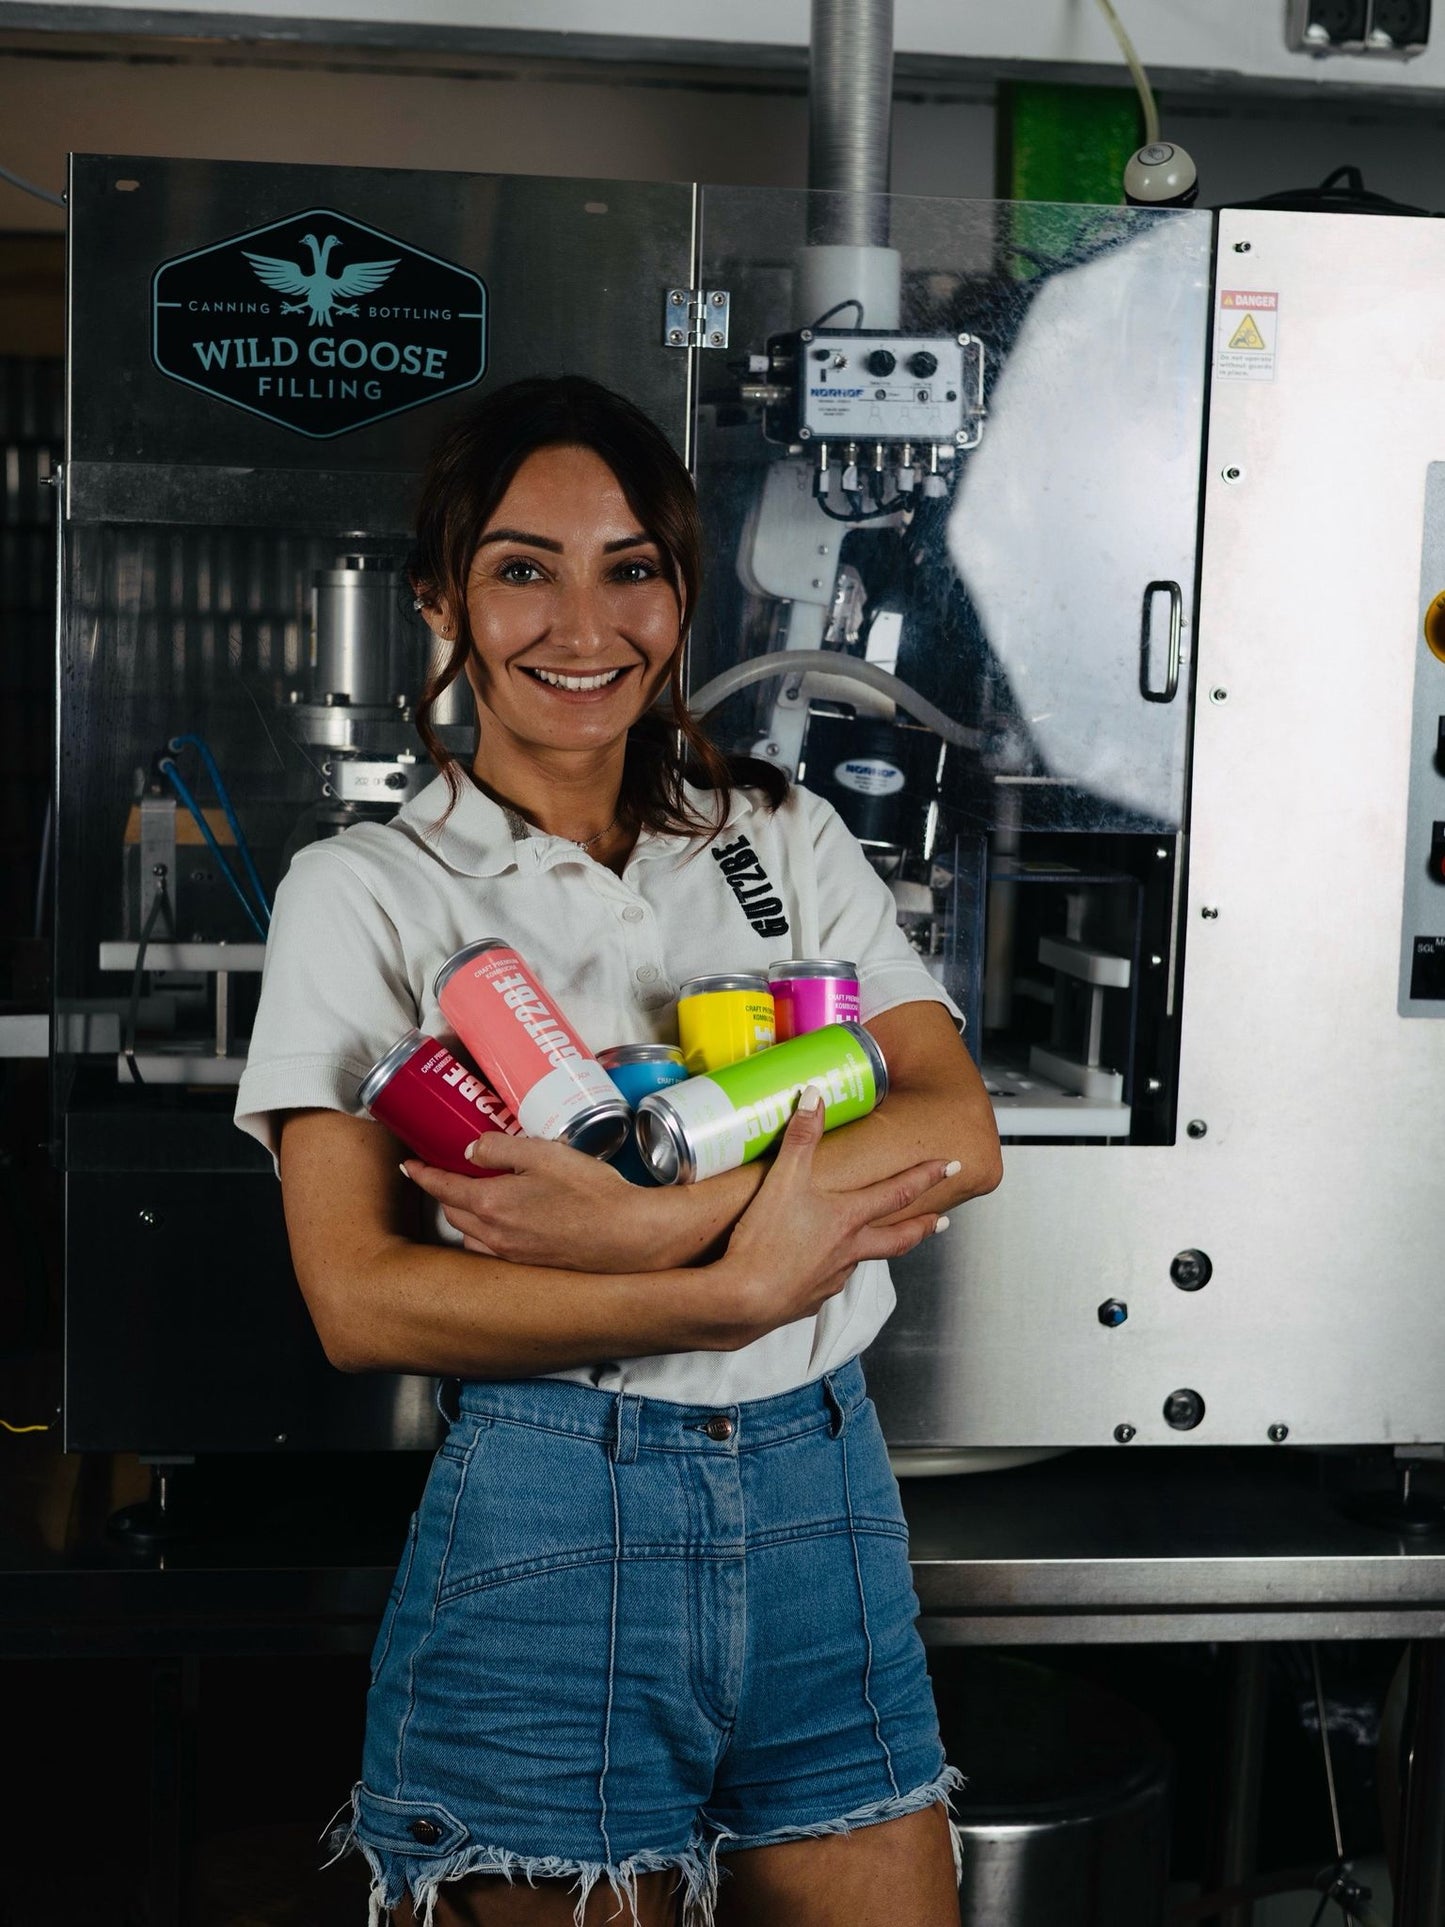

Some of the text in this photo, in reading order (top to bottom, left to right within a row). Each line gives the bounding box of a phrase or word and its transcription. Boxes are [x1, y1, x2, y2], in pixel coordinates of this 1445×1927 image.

[188, 300, 452, 321] CANNING BOTTLING
[1235, 295, 1275, 307] DANGER
[193, 337, 448, 380] WILD GOOSE
[258, 377, 383, 400] FILLING
[810, 387, 864, 398] NORHOF
[711, 834, 789, 938] GUT2BE
[474, 964, 493, 978] CRAFT
[492, 972, 584, 1069] GUT2BE
[421, 1057, 437, 1074] CRAFT
